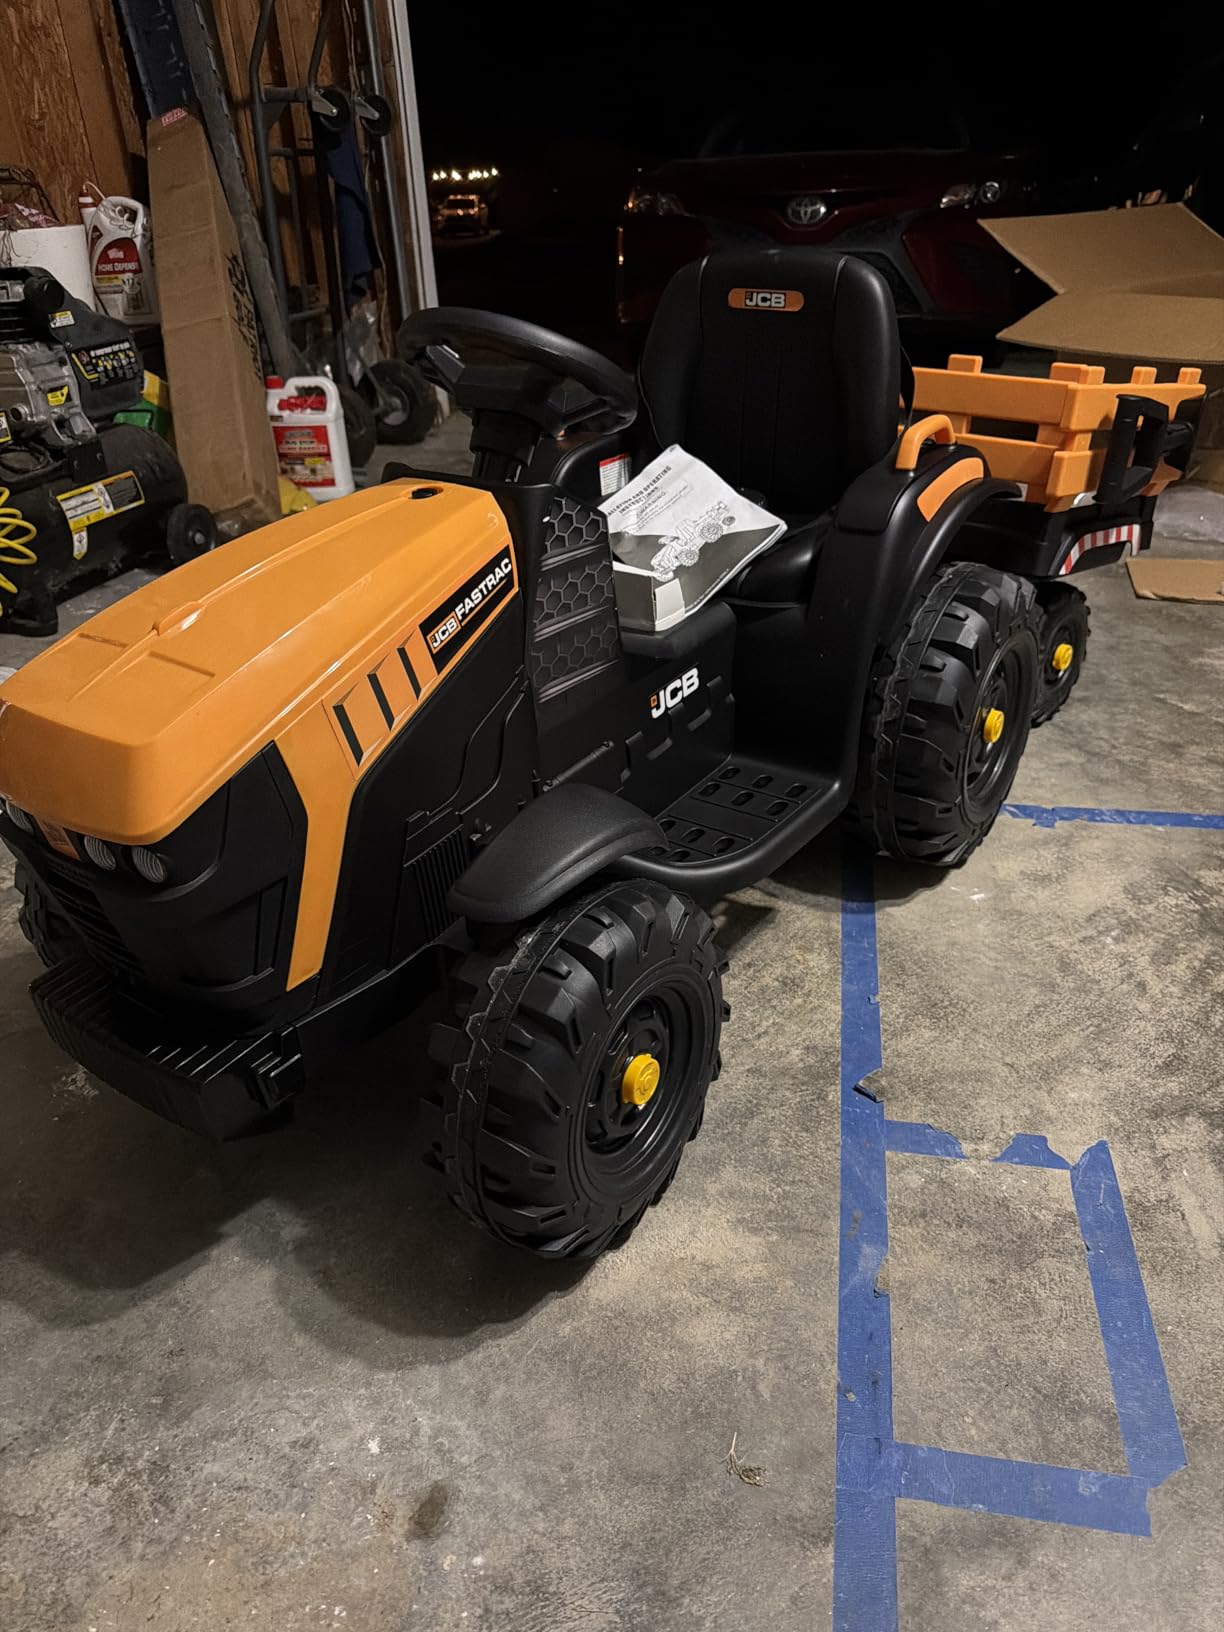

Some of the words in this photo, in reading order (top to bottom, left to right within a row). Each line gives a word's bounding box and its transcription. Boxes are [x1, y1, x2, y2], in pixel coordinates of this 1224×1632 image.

[745, 292, 785, 307] JCB
[643, 465, 672, 492] OPERATING
[431, 617, 458, 648] JCB
[455, 558, 512, 620] FASTRAC
[651, 667, 700, 719] JCB
